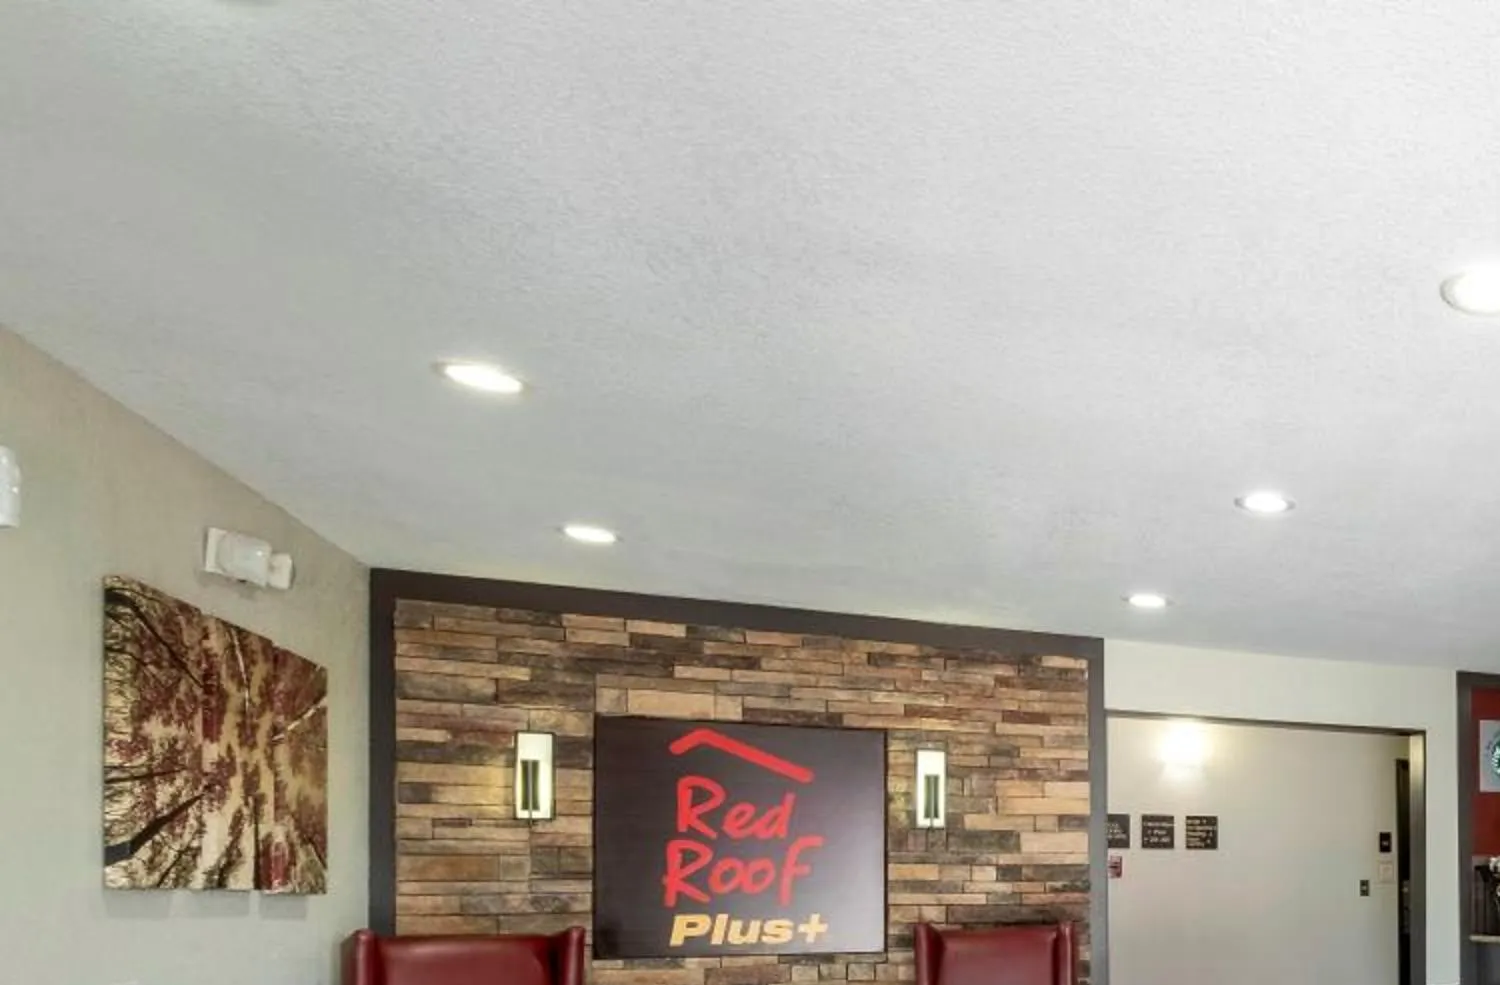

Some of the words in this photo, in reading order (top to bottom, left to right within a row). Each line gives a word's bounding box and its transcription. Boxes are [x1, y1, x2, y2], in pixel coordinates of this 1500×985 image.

[676, 775, 796, 840] Red
[662, 834, 826, 908] Roof
[669, 913, 829, 947] Plus+
